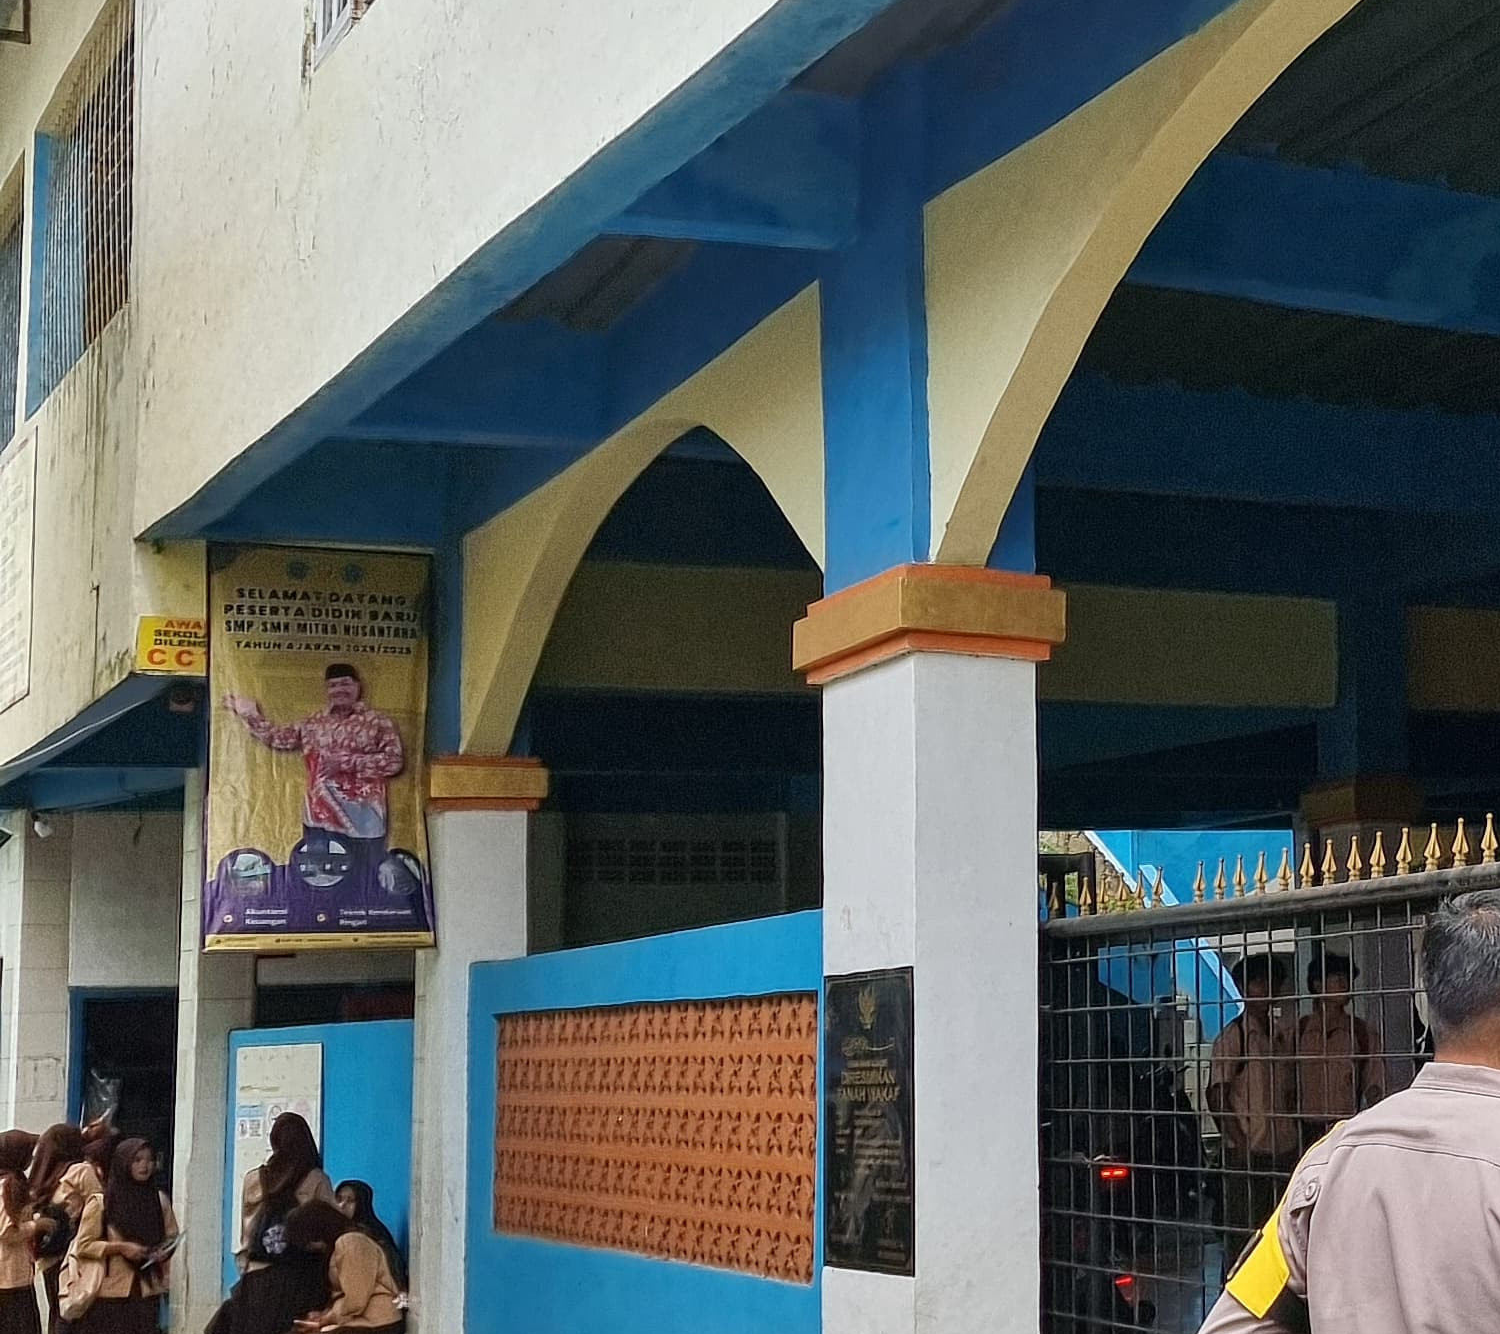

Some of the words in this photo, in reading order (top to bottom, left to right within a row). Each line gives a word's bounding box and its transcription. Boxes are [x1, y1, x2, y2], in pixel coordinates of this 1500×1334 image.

[236, 588, 323, 602] SELAMAT
[329, 593, 407, 607] DATANG
[224, 604, 305, 618] PESERTA
[311, 608, 363, 620] DIDIK
[369, 610, 418, 623] BARU
[224, 620, 254, 634] SMP
[261, 621, 290, 634] SMK
[297, 623, 337, 636] MITRA
[344, 623, 418, 640] NUSANTARA
[235, 640, 280, 650] TAHUN
[286, 642, 341, 652] AJARAN
